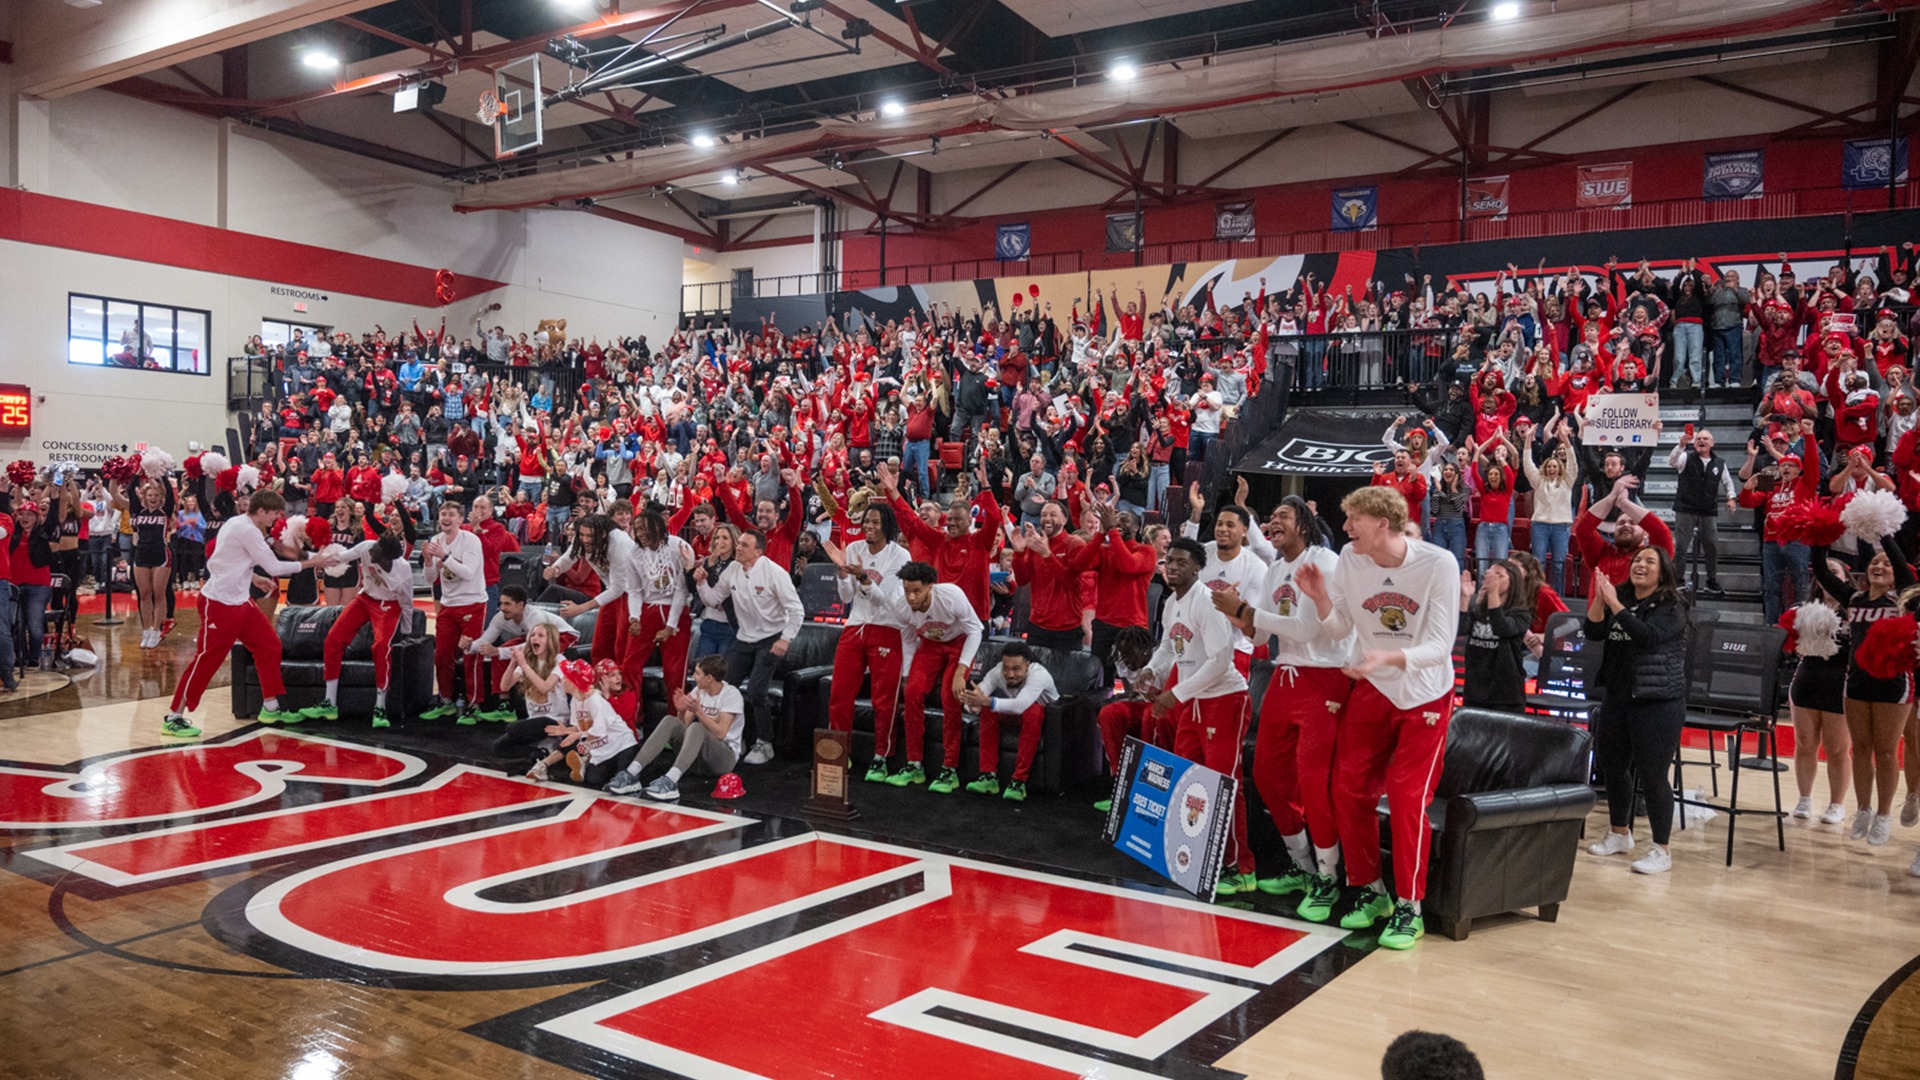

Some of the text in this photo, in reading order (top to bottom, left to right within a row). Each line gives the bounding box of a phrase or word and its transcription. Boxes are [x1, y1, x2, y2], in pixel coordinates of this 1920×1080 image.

[1583, 180, 1627, 196] SIUE
[1472, 200, 1504, 211] SEMO
[270, 286, 320, 301] RESTROOMS
[2, 405, 28, 426] 25
[1602, 408, 1638, 419] FOLLOW
[42, 440, 119, 453] CONCESSIONS
[1293, 445, 1396, 464] BJC
[137, 516, 165, 525] SIUE
[1722, 642, 1747, 652] SIUE
[1147, 760, 1166, 776] MARCH
[1147, 771, 1171, 790] MADNESS
[1132, 793, 1149, 809] 2025
[1147, 799, 1167, 818] TICKET
[1186, 794, 1206, 814] SIUE
